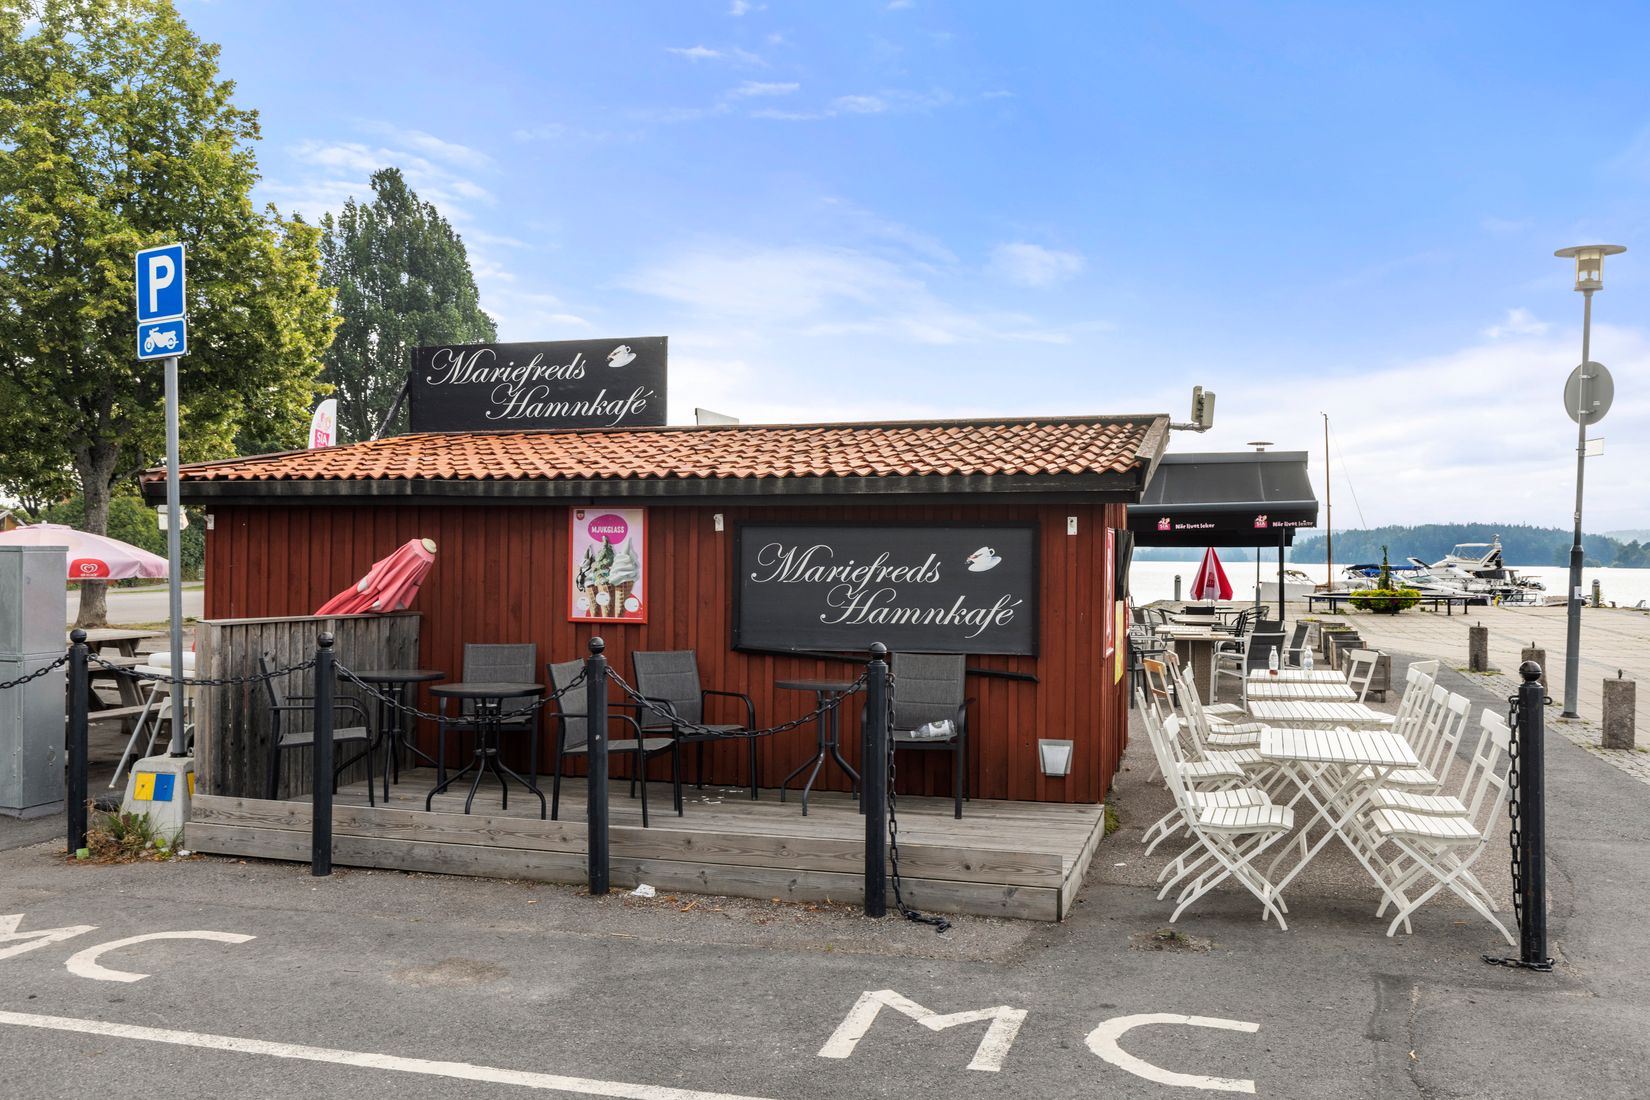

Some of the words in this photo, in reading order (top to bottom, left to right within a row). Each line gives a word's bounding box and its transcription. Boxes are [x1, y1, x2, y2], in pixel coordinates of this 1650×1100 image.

[148, 254, 176, 313] P
[426, 348, 587, 392] Mariefreds
[485, 382, 654, 427] Hamnkafé
[591, 526, 625, 534] MJUKGLASS
[750, 542, 942, 595] Mariefreds
[819, 583, 1023, 639] Hamnkafé
